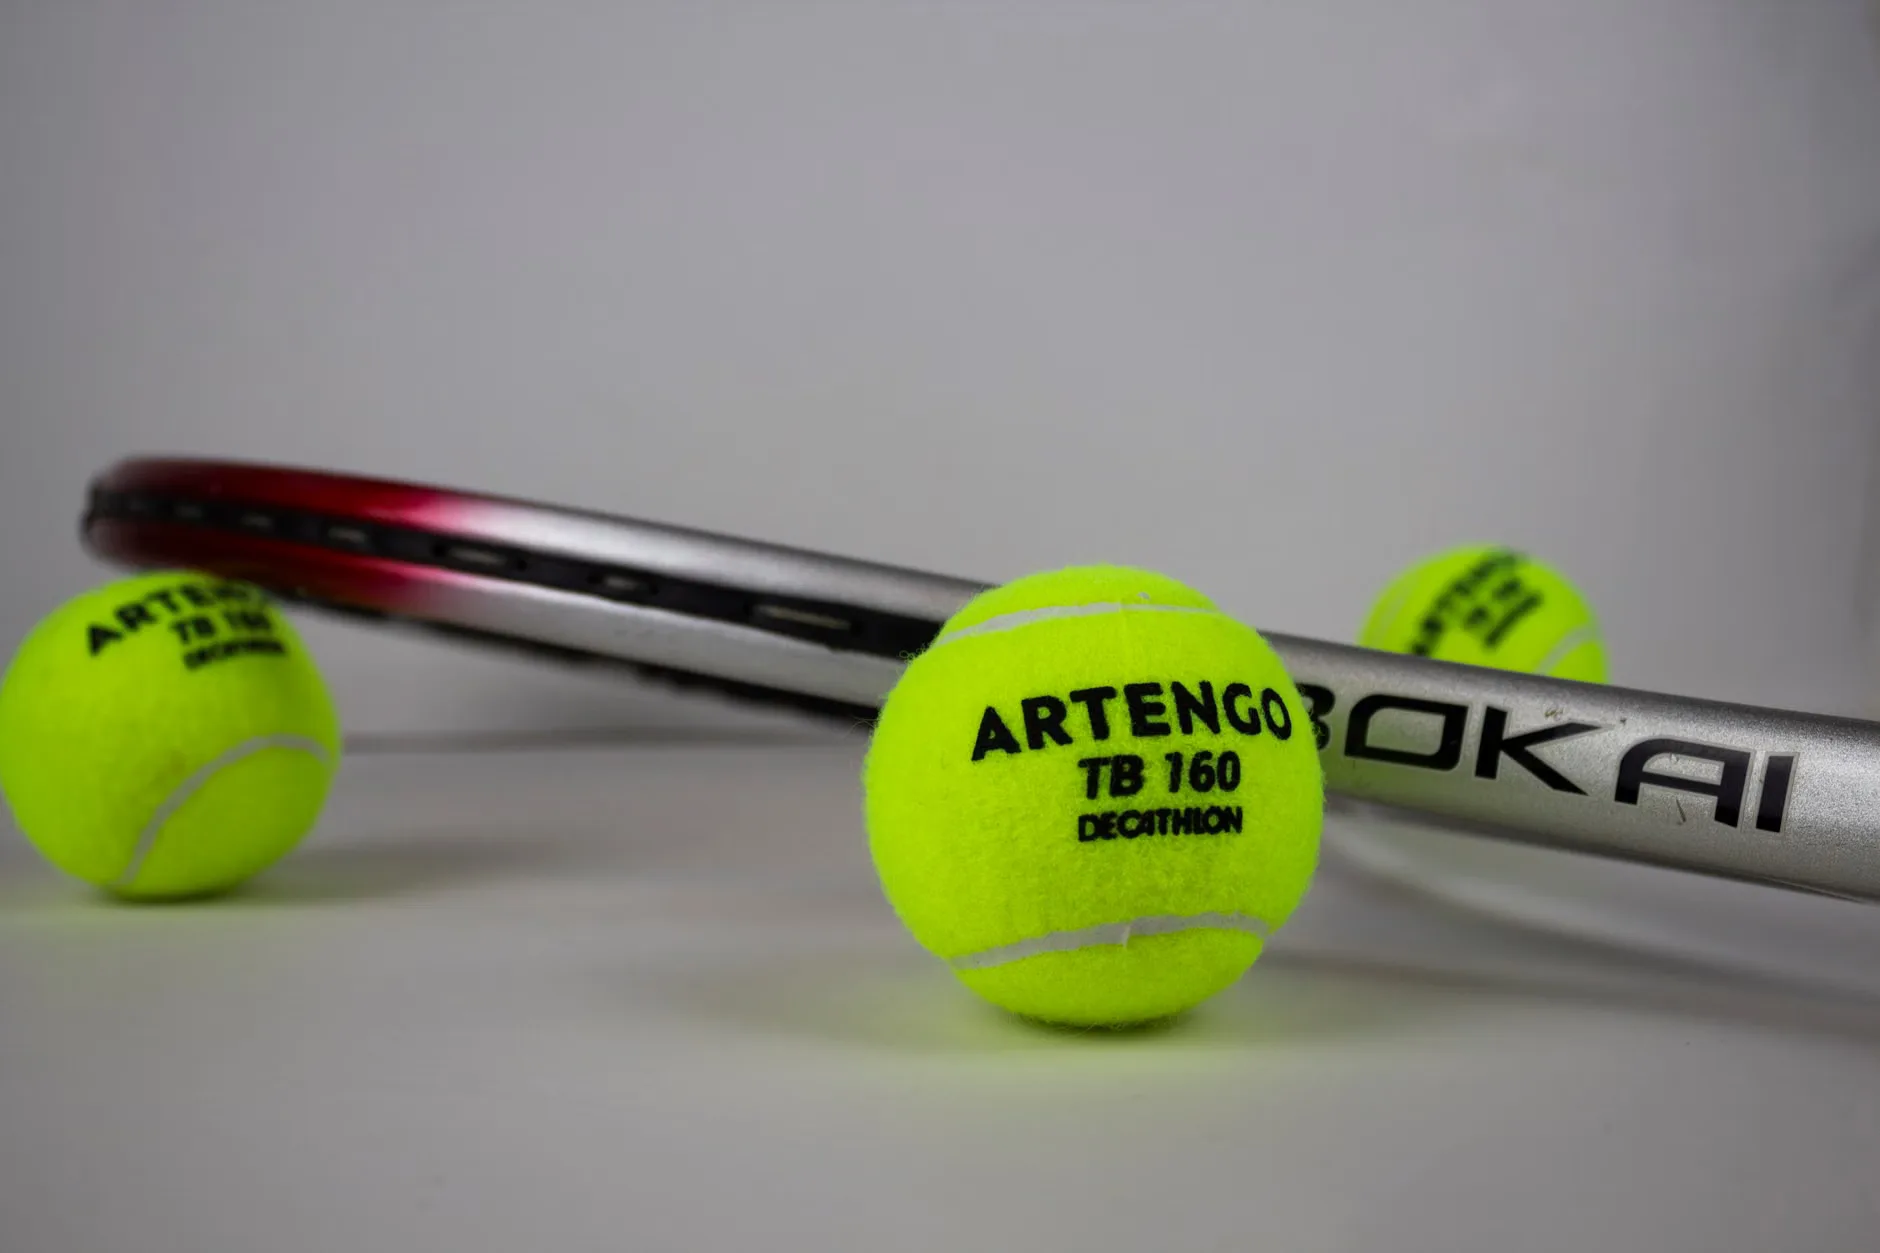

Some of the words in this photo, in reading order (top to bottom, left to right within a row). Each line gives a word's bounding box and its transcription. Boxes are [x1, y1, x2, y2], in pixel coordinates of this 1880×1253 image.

[88, 584, 262, 656] ARTE
[971, 681, 1292, 761] ARTENGO
[1078, 755, 1144, 800] TB
[1166, 751, 1241, 793] 160
[1078, 806, 1243, 842] DECATHLON
